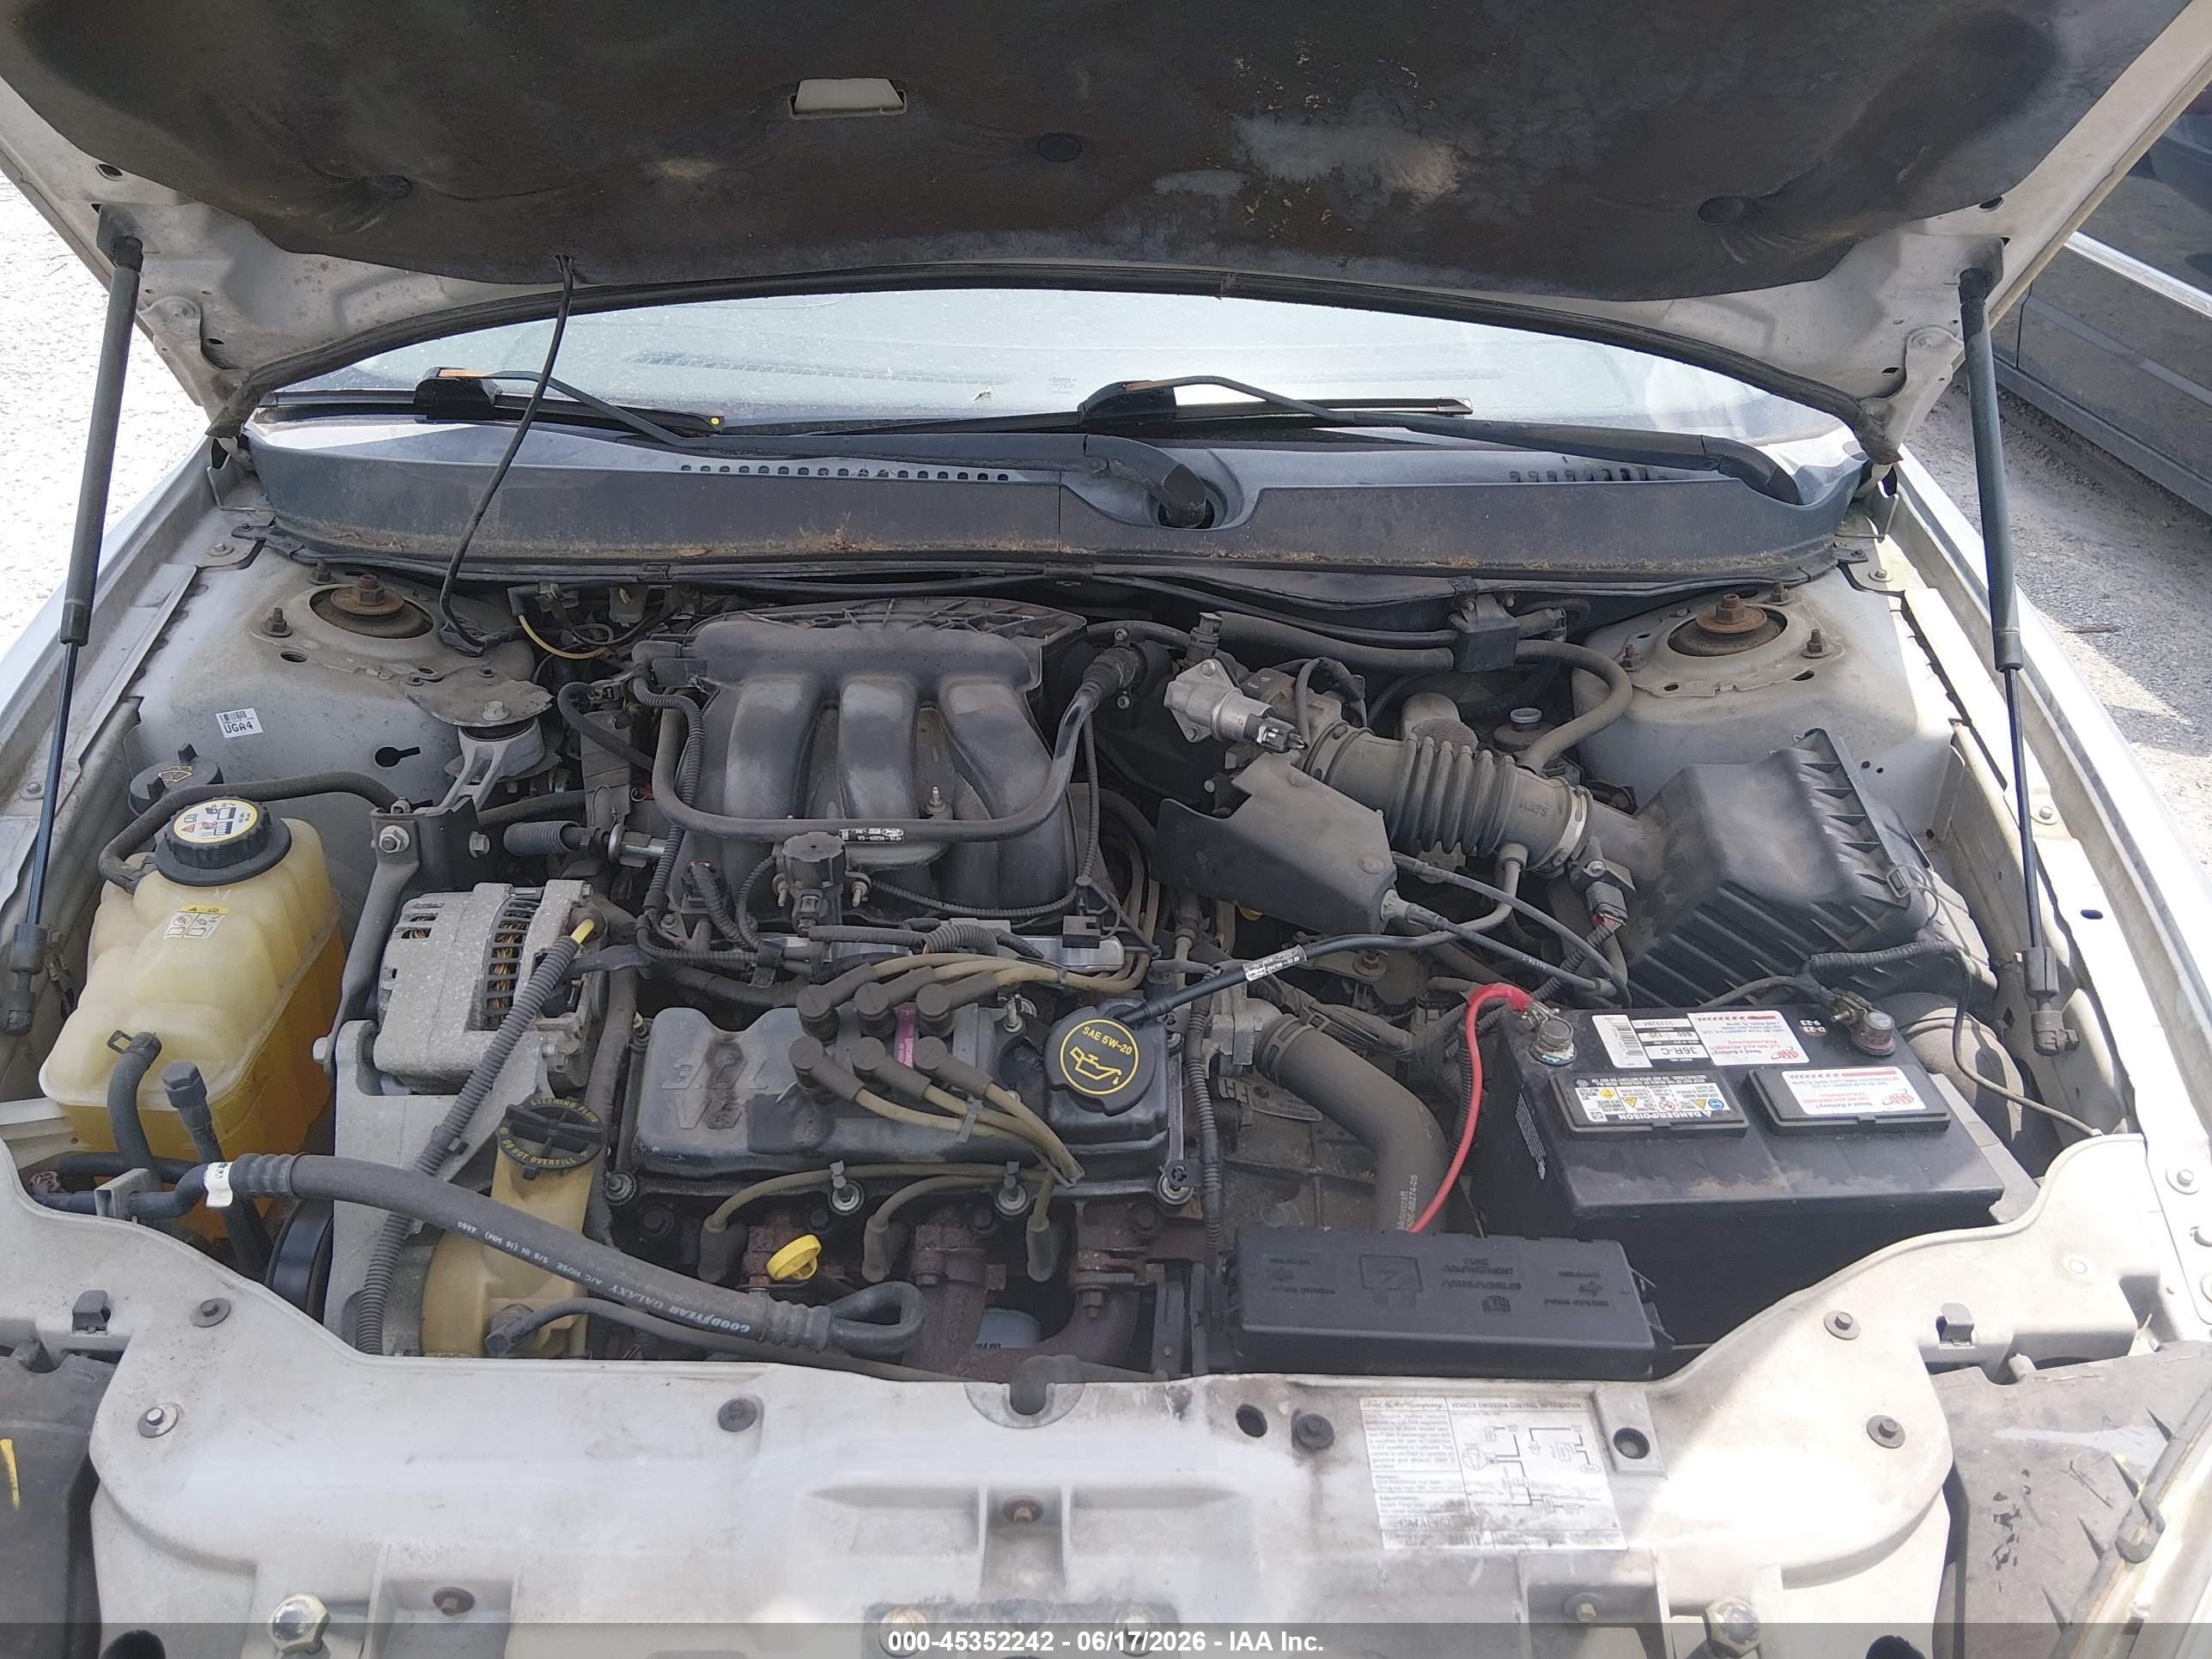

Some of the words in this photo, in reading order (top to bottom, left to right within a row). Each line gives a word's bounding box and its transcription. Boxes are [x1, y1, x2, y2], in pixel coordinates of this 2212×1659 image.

[224, 721, 253, 734] UGA4
[1082, 1026, 1101, 1041] SAE
[1101, 1035, 1132, 1054] 5W-20
[1659, 1047, 1698, 1056] 36R-C
[529, 1097, 577, 1109] STEERING
[577, 1105, 600, 1125] FLUID
[1617, 1111, 1701, 1121] DANGER/POISON
[501, 1139, 517, 1150] DO
[513, 1147, 538, 1160] NOT
[530, 1156, 577, 1167] OVERFILL
[520, 1246, 532, 1257] IN
[556, 1261, 582, 1279] HOSE
[584, 1273, 604, 1287] A/C
[607, 1284, 665, 1310] GALAXY
[668, 1304, 752, 1334] GOODYEAR
[1451, 1401, 1478, 1409] VEHICLE
[1478, 1401, 1510, 1409] EMISSION
[1510, 1401, 1539, 1409] CONTROL
[1539, 1401, 1582, 1409] INFORMATION
[1400, 1517, 1453, 1528] CATALYST
